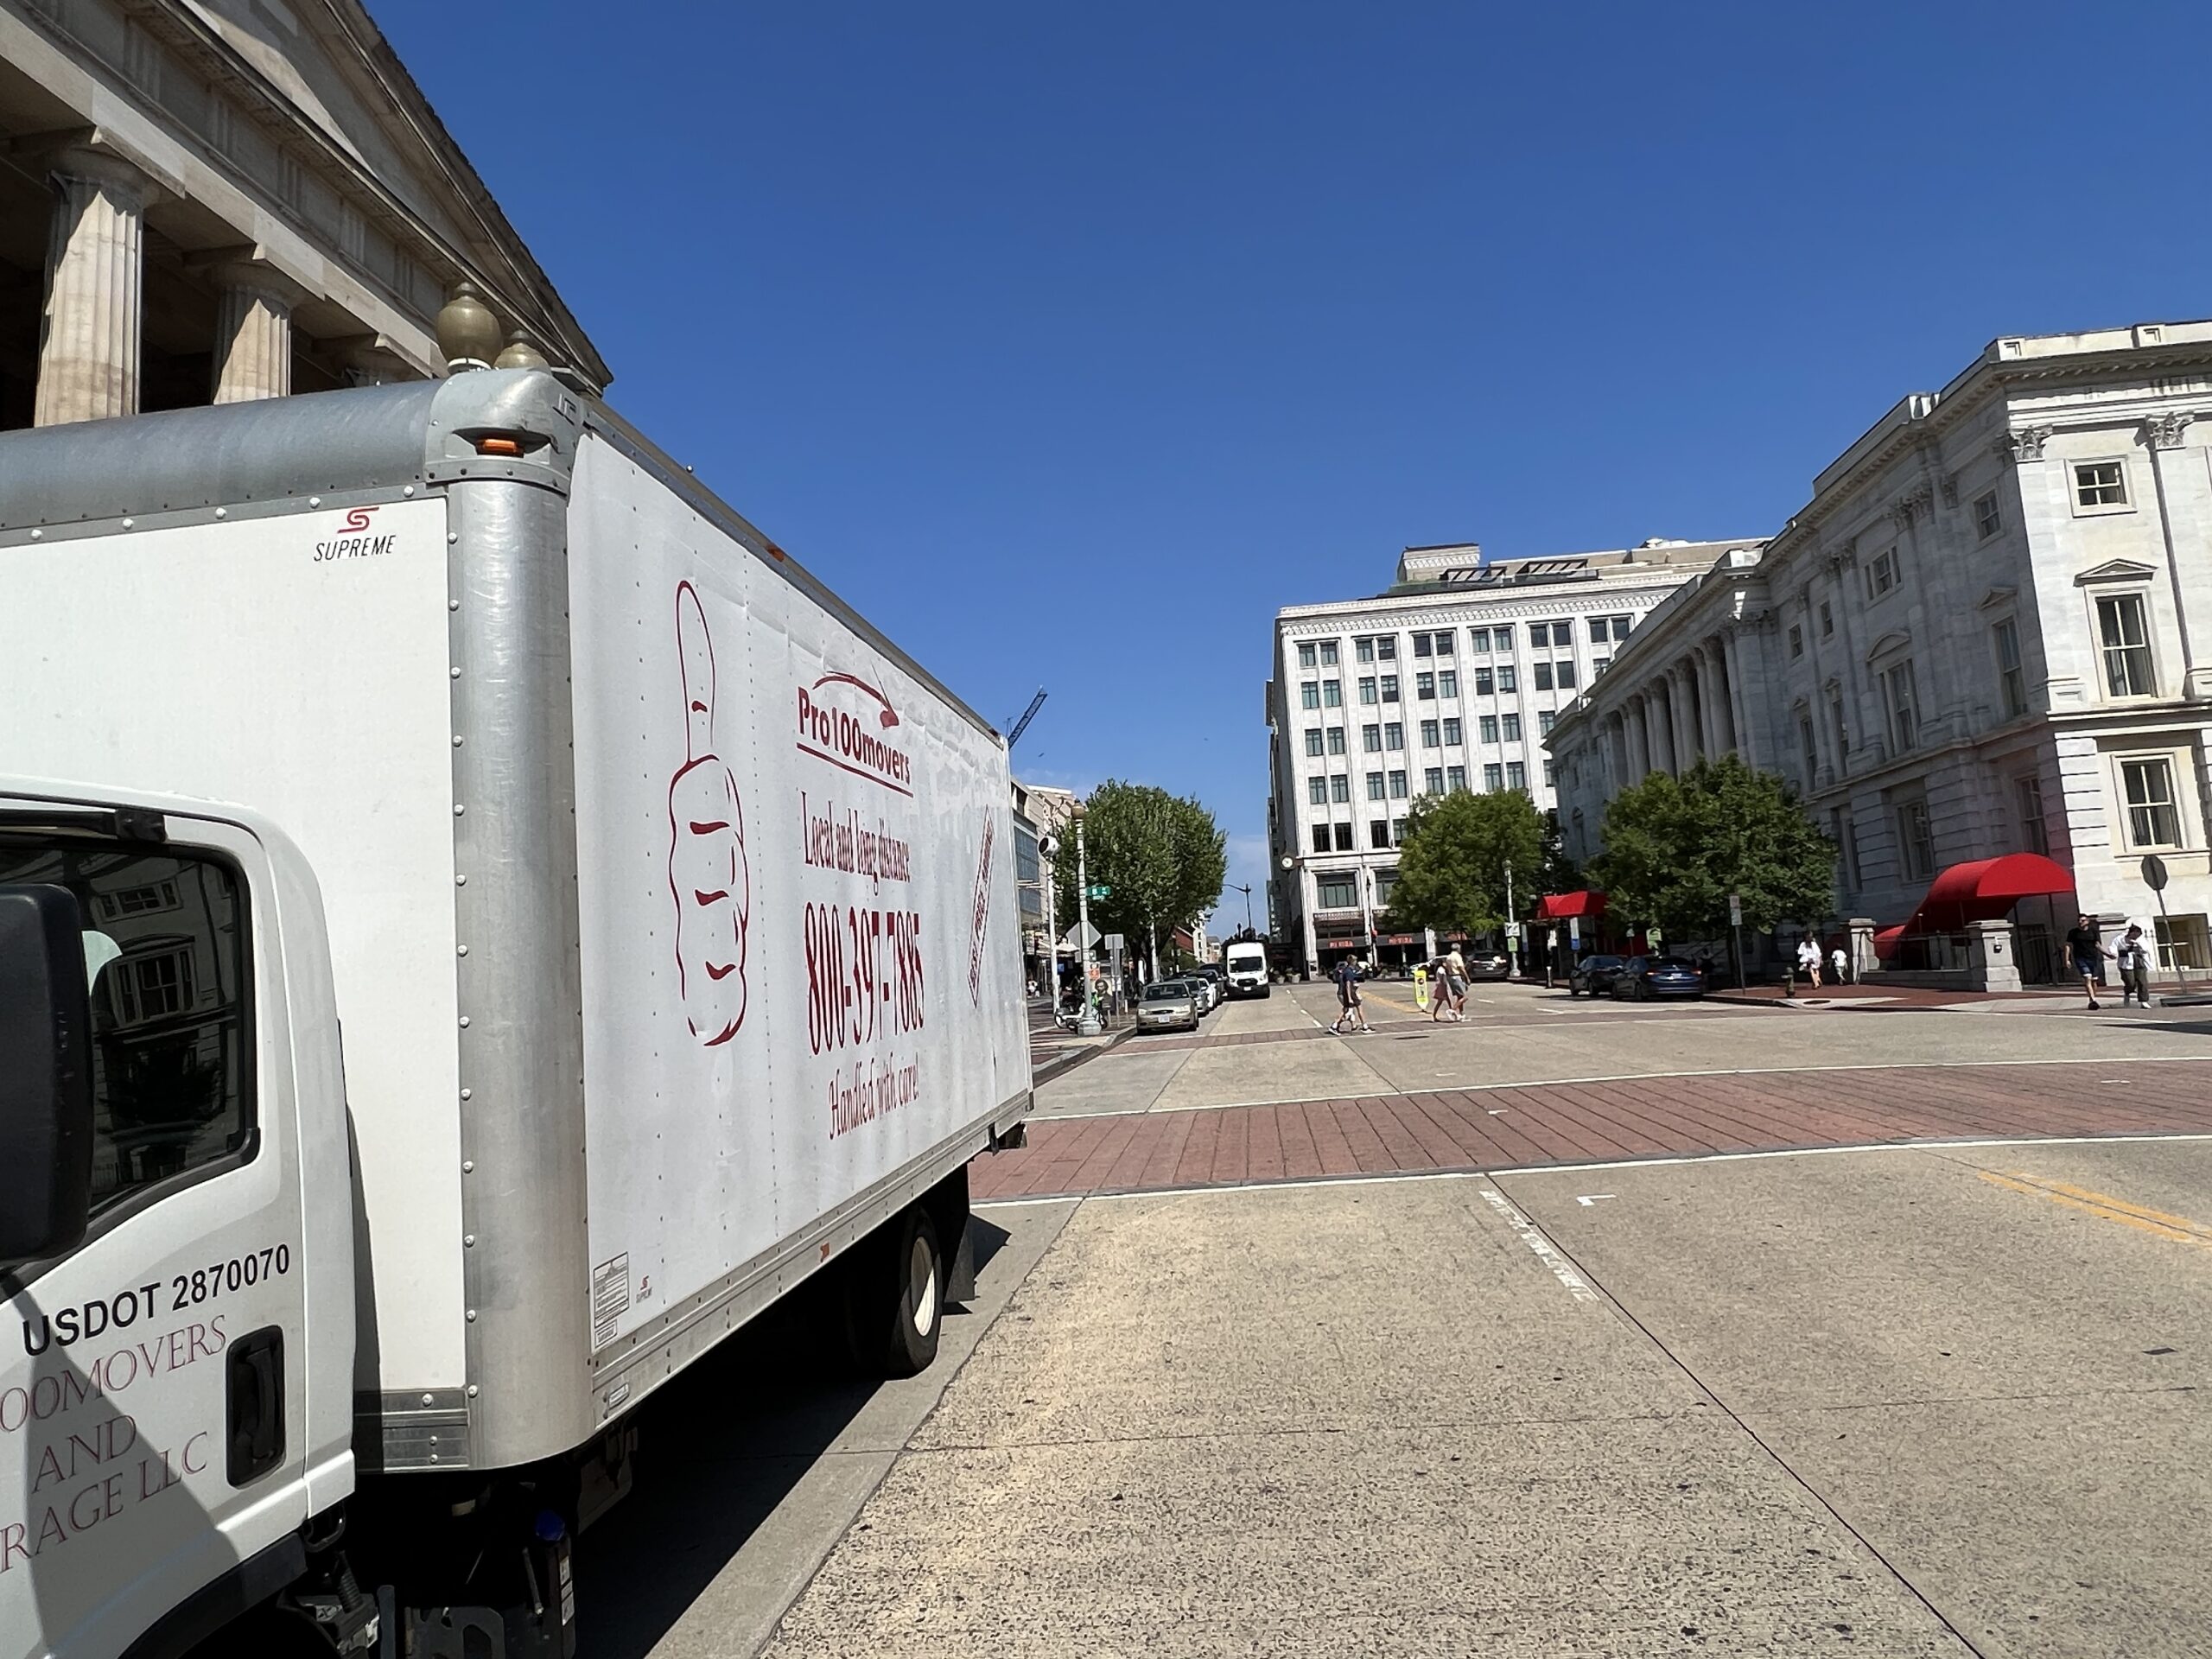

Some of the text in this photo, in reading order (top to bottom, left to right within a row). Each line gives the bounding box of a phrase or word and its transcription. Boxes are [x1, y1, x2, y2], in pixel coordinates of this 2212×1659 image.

[314, 535, 397, 562] SUPREME
[798, 686, 911, 786] Pro100movers
[801, 791, 911, 896] Local and long distance
[805, 901, 925, 1056] 800-397-7885
[830, 1057, 875, 1140] Handled
[876, 1051, 897, 1121] with
[22, 1243, 290, 1357] USDOT 2870070
[31, 1414, 137, 1495] AND
[137, 1431, 209, 1503] LLC
